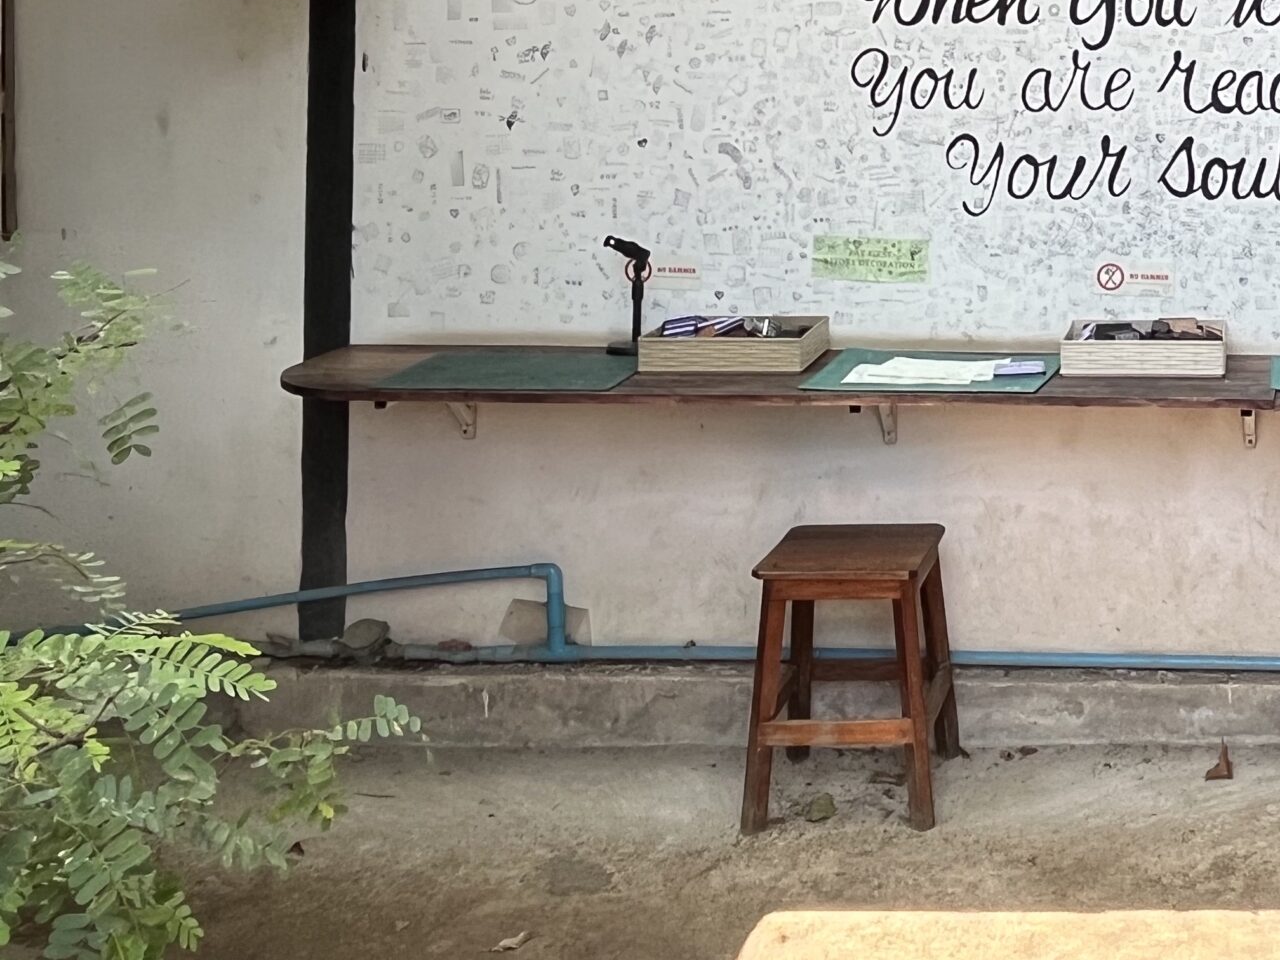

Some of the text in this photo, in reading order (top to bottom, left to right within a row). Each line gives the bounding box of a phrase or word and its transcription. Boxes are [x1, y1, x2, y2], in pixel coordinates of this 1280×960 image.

[850, 47, 985, 137] You
[1021, 51, 1135, 113] are
[945, 133, 1132, 217] Your
